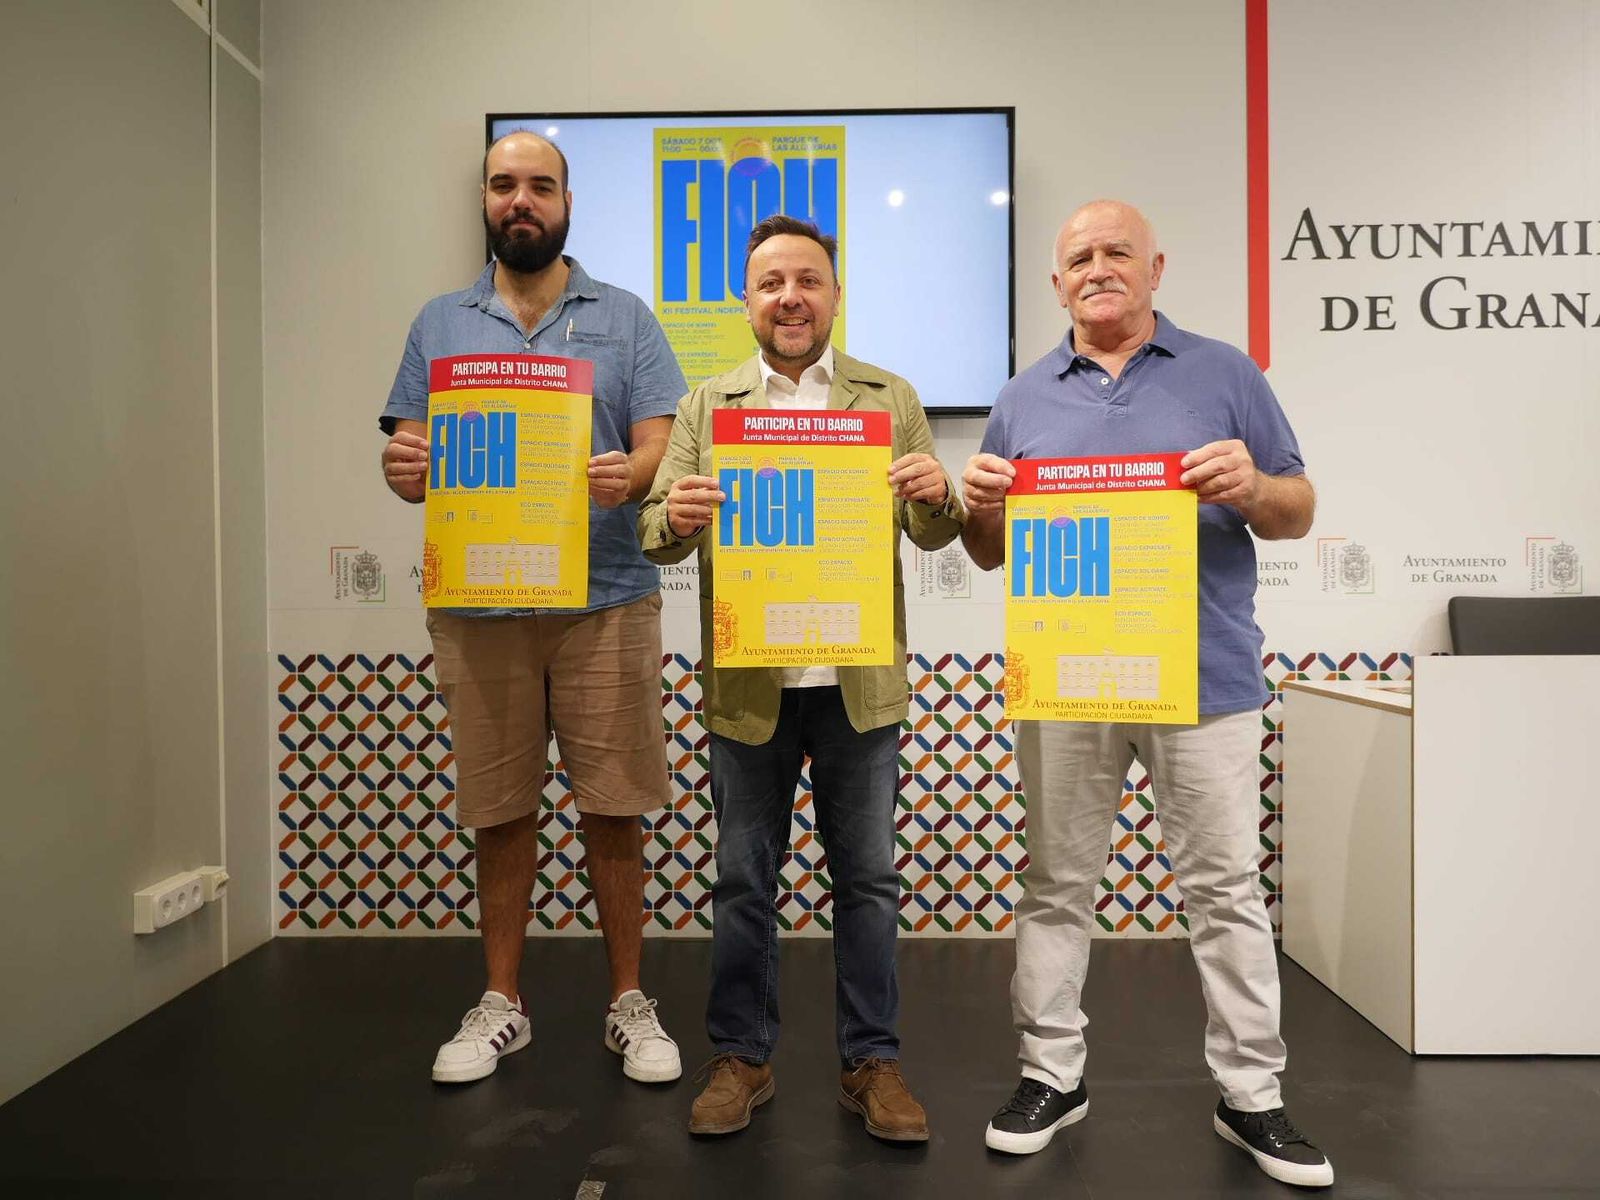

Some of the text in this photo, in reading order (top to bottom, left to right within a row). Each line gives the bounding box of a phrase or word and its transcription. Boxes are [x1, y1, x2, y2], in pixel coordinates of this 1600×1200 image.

[1281, 207, 1600, 260] AYUNTAMI
[1320, 276, 1600, 331] DE GRAN
[452, 362, 566, 378] PARTICIPA EN TU BARRIO
[468, 378, 502, 386] Municipal
[514, 378, 541, 386] Distrito
[542, 380, 568, 388] CHANA
[744, 417, 863, 431] PARTICIPA EN TU BARRIO
[764, 434, 799, 442] Municipal
[430, 412, 517, 489] FICH
[1038, 462, 1164, 480] PARTICIPA EN TU BARRIO
[1057, 482, 1094, 490] Municipal
[1137, 480, 1166, 488] CHANA
[719, 467, 814, 546] FICH
[1012, 517, 1110, 597] FICH
[1404, 555, 1506, 568] AYUNTAMIENTO
[1257, 578, 1289, 586] NADA
[1412, 570, 1498, 583] DE GRANADA
[444, 587, 572, 596] AYUNTAMIENTO DE GRANADA
[661, 582, 691, 590] NADA
[742, 646, 814, 656] AYUNTAMIENTO
[832, 645, 876, 654] GRANADA
[1032, 699, 1178, 711] AYUNTAMIENTO DE GRANADA
